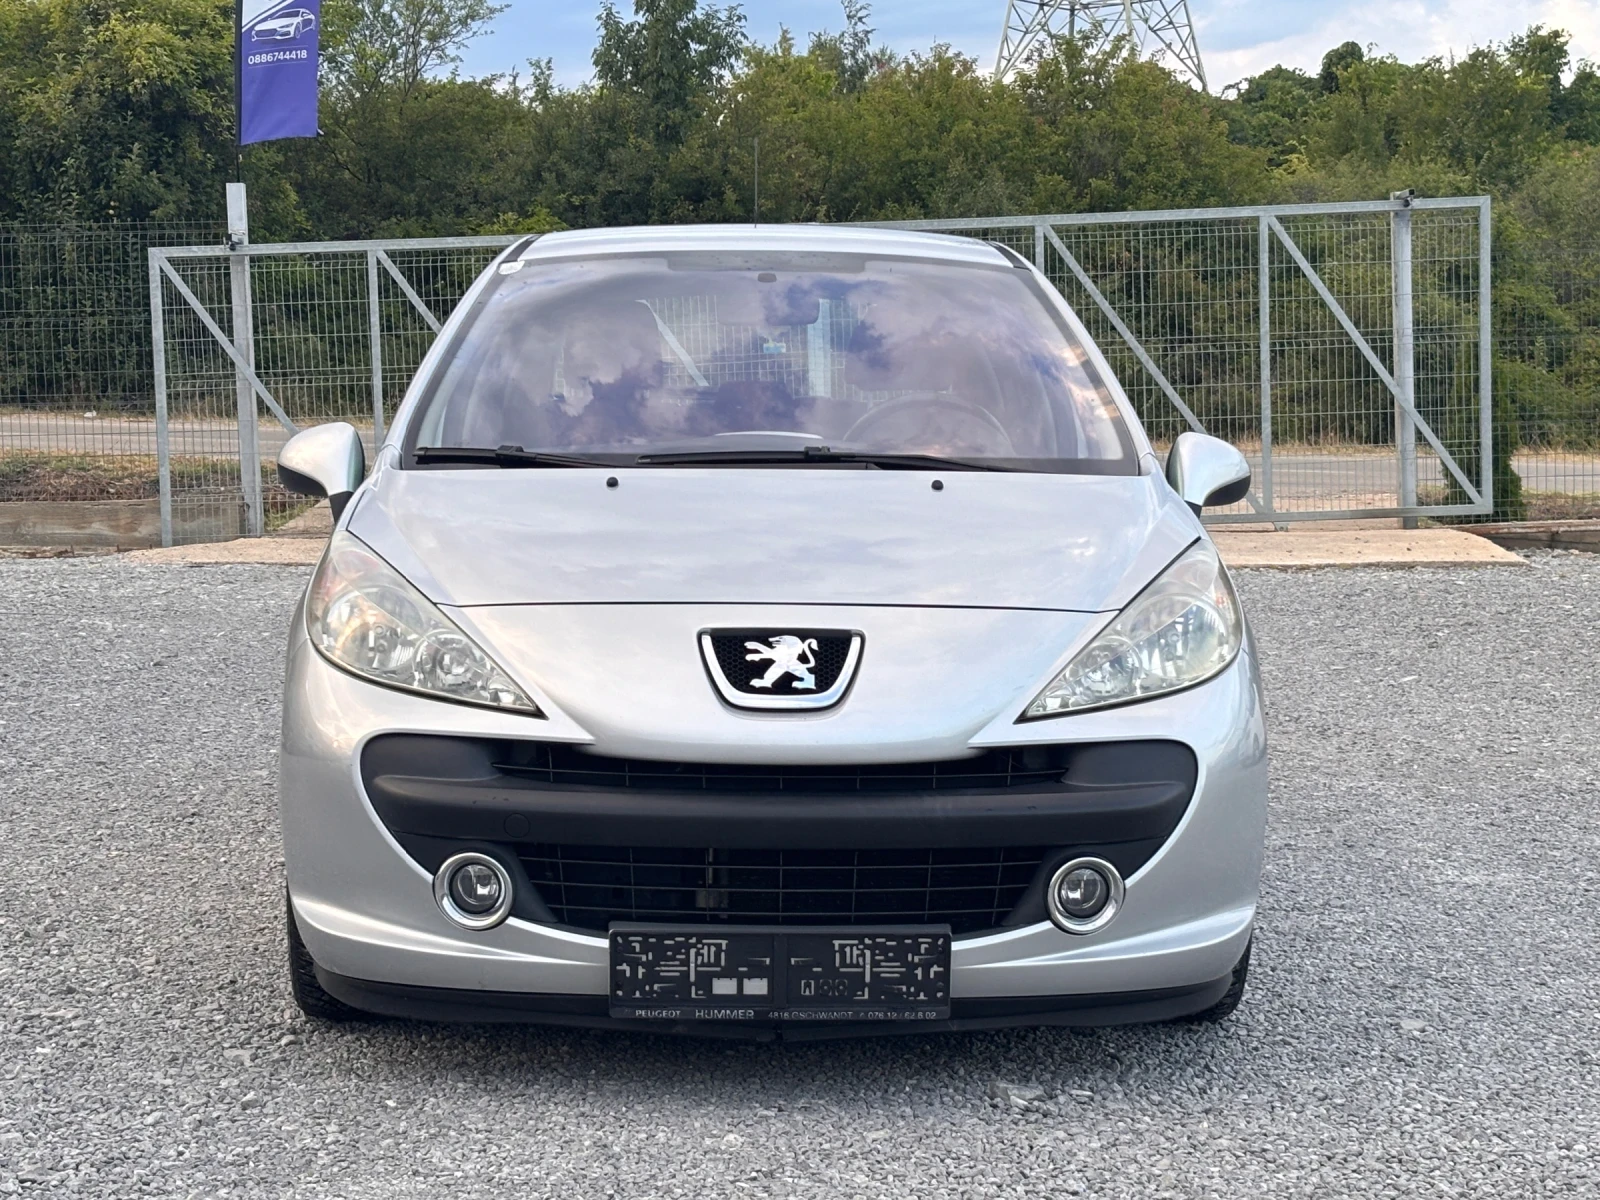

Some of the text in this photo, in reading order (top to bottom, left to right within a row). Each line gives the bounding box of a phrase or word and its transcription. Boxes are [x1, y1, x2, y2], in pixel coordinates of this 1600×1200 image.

[247, 49, 308, 65] 0886744418
[635, 1009, 681, 1018] PEUGEOT
[695, 1009, 754, 1020] HUMMER
